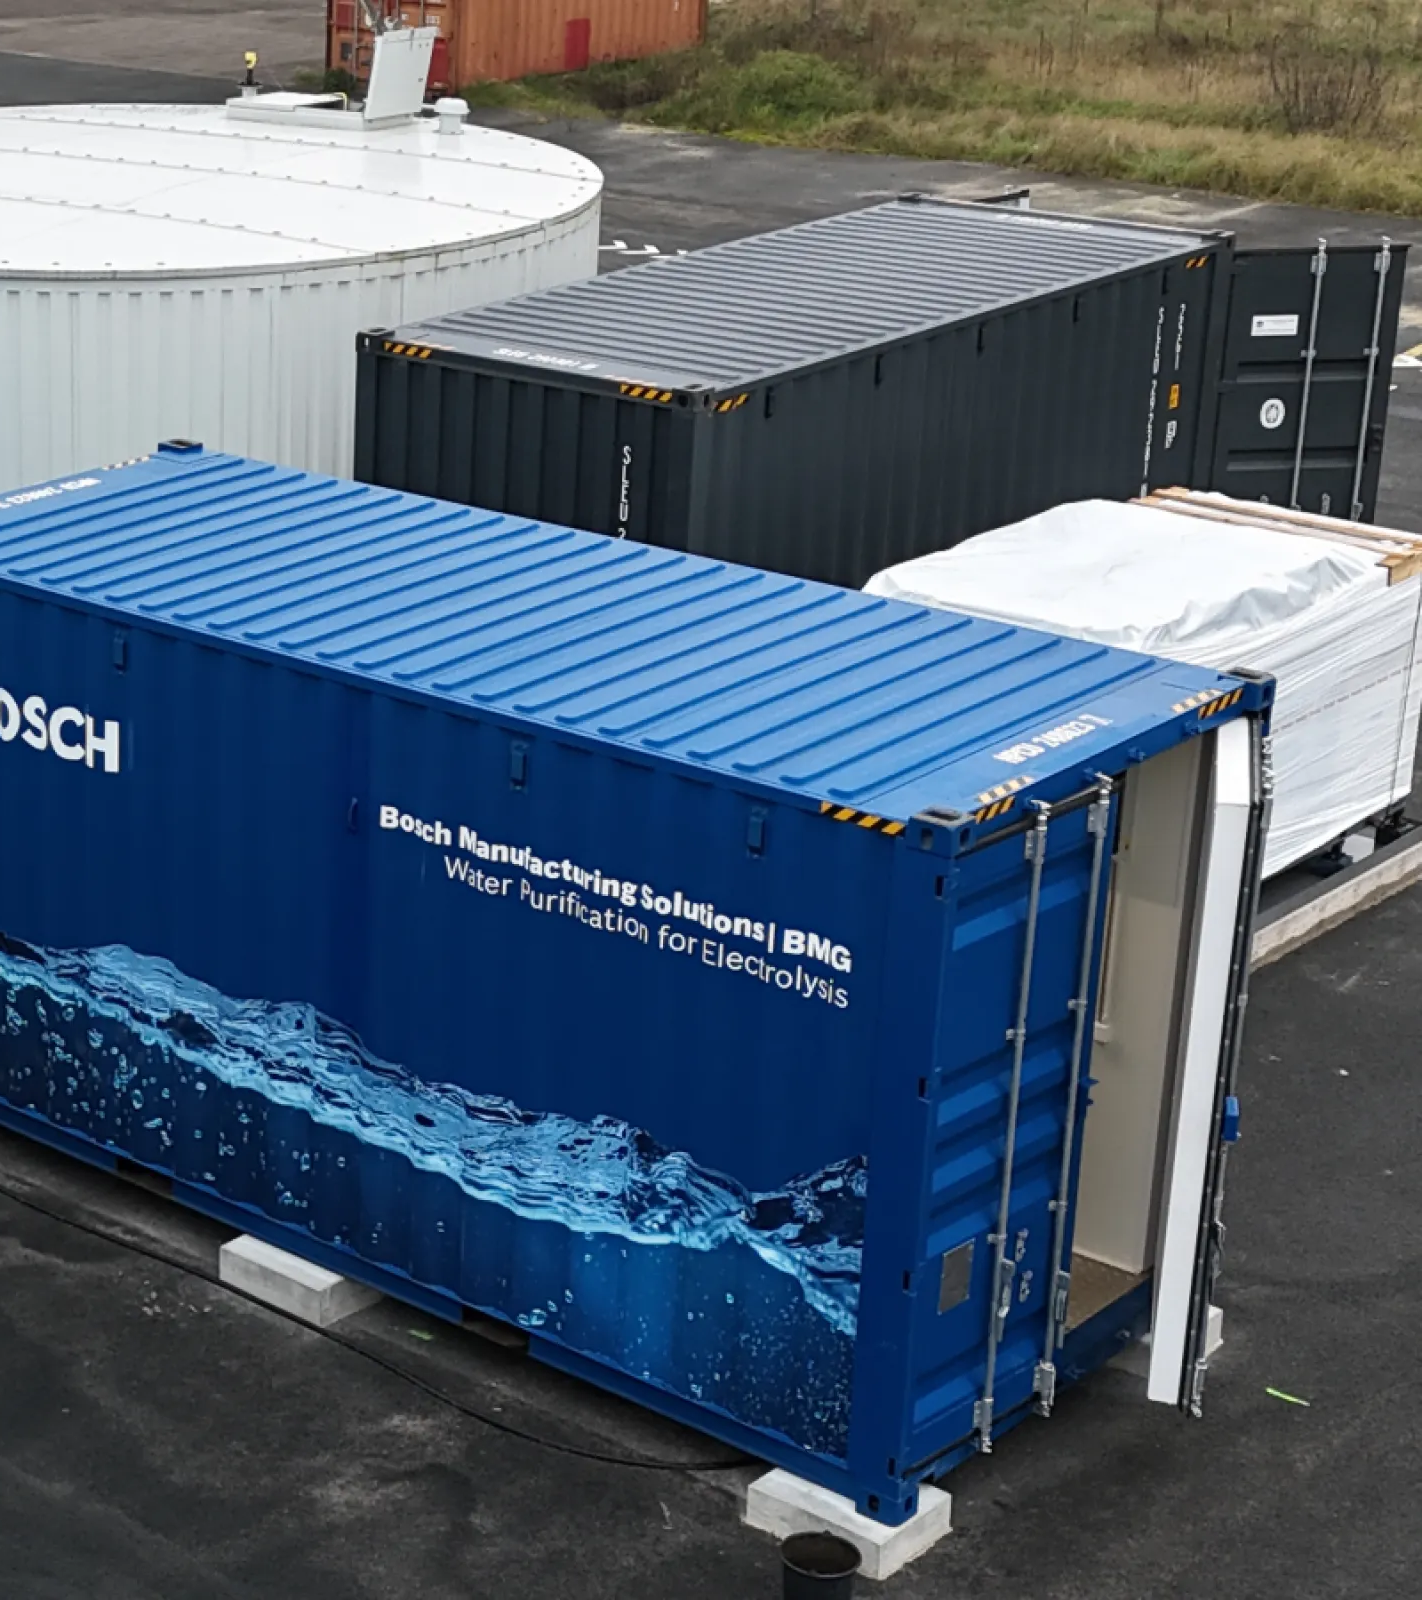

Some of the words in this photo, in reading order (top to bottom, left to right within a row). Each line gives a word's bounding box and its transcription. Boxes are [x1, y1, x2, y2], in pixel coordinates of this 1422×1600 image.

[619, 445, 632, 522] SLEU
[379, 804, 453, 847] Bosch
[459, 825, 638, 908] Manufacturing
[640, 884, 766, 943] Solutions
[783, 929, 852, 974] BMG
[443, 855, 514, 896] Water
[520, 878, 650, 945] Purification
[657, 924, 699, 956] for
[701, 937, 849, 1009] Electrolysis
